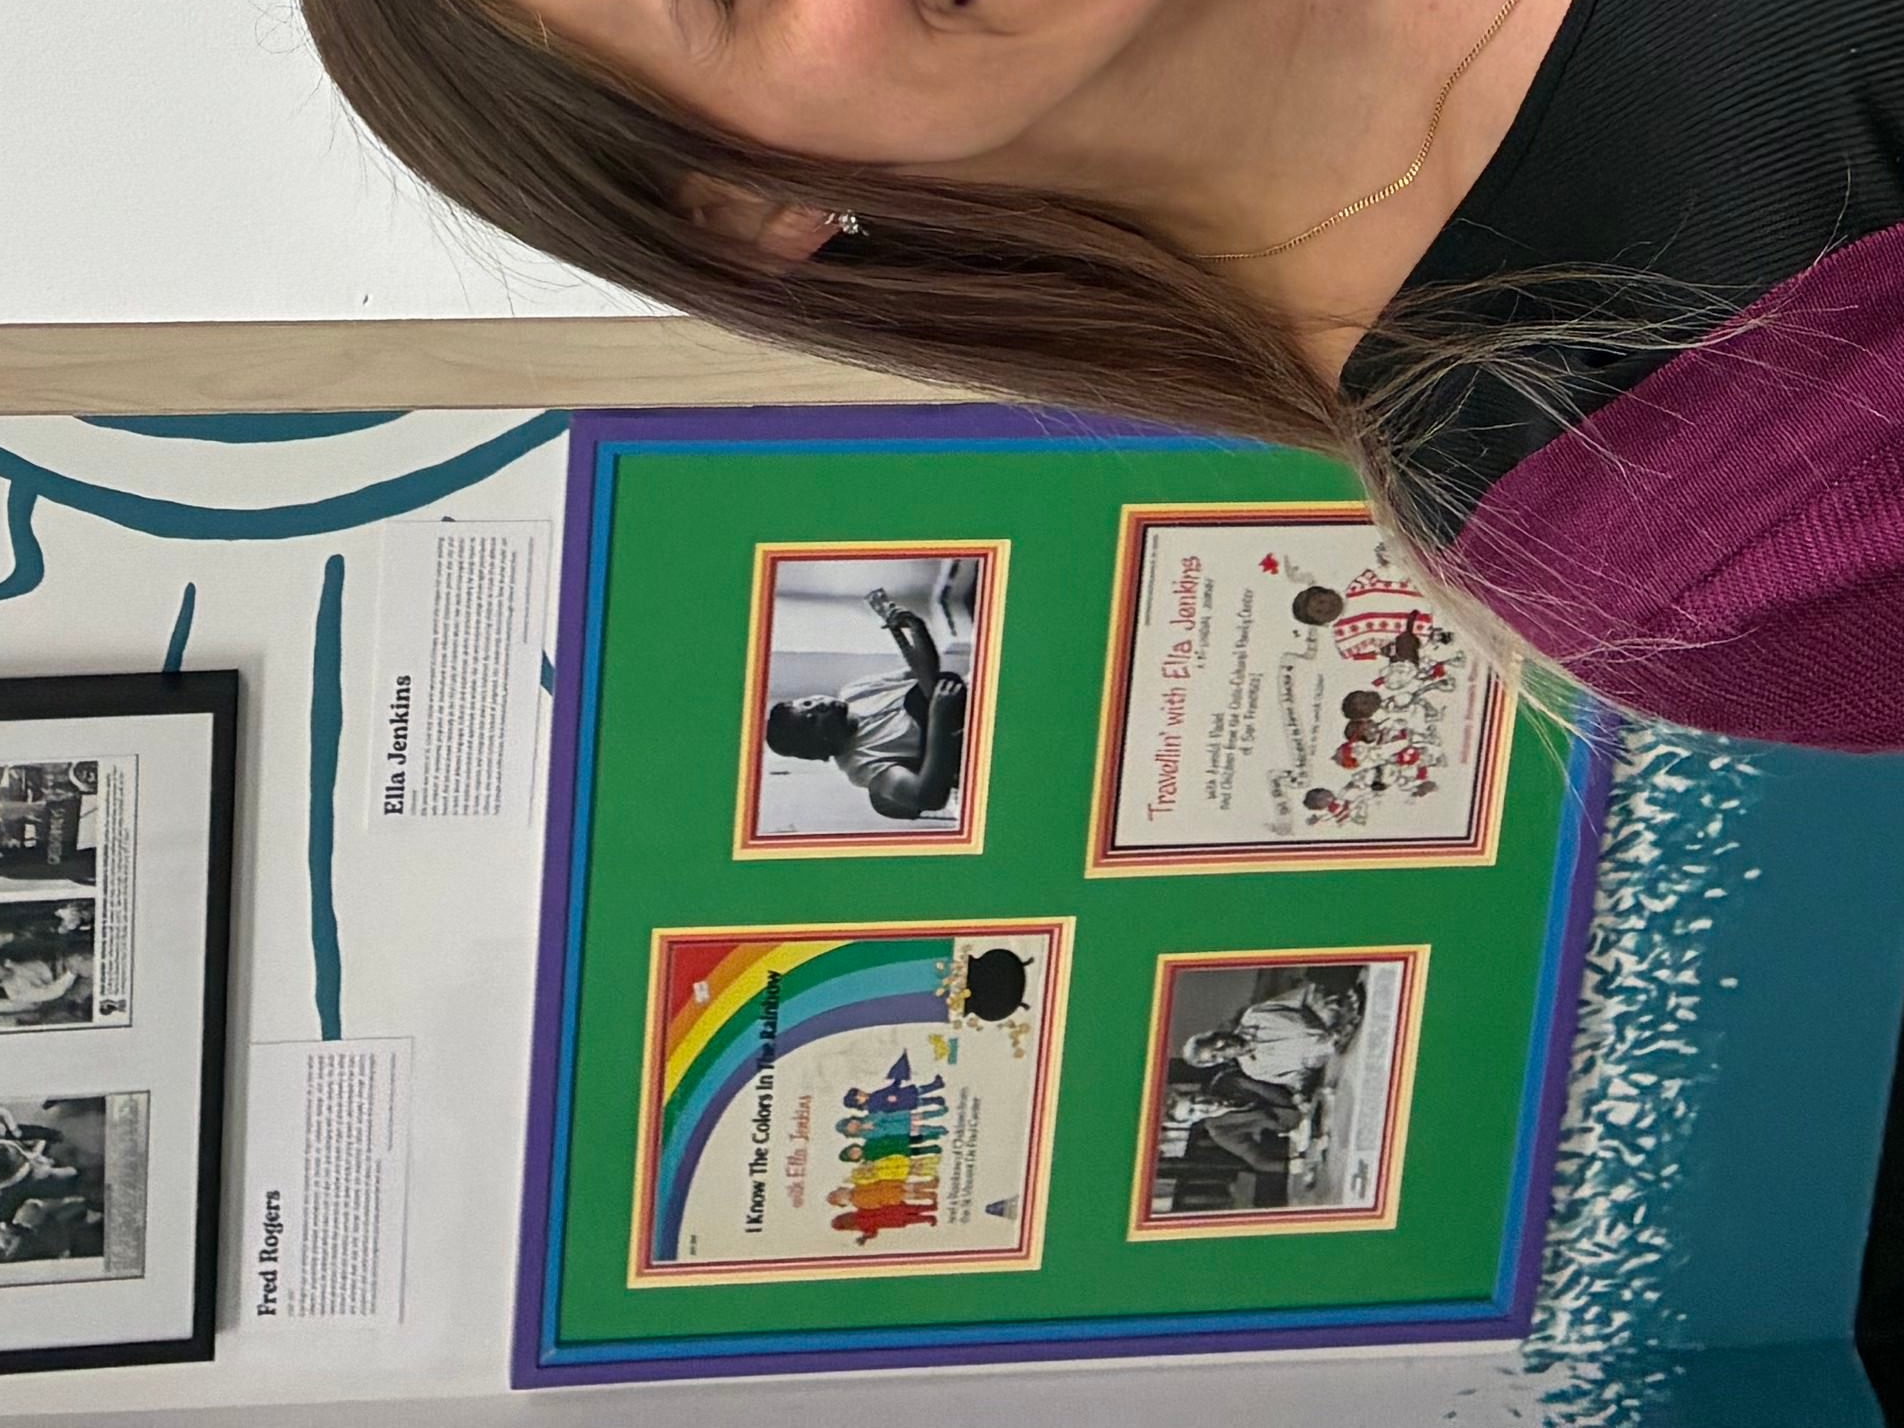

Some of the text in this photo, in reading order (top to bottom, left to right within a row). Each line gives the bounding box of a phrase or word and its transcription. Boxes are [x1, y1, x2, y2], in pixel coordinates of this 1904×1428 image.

[1147, 556, 1202, 822] Travellin' with Ella Jenkins
[384, 675, 411, 815] Ella Jenkins
[759, 969, 782, 1040] Rainbow
[755, 1073, 775, 1091] In
[757, 1041, 777, 1071] The
[751, 1092, 774, 1145] Colors
[748, 1146, 770, 1176] The
[746, 1179, 768, 1225] Know
[257, 1190, 284, 1316] Fred Rogers
